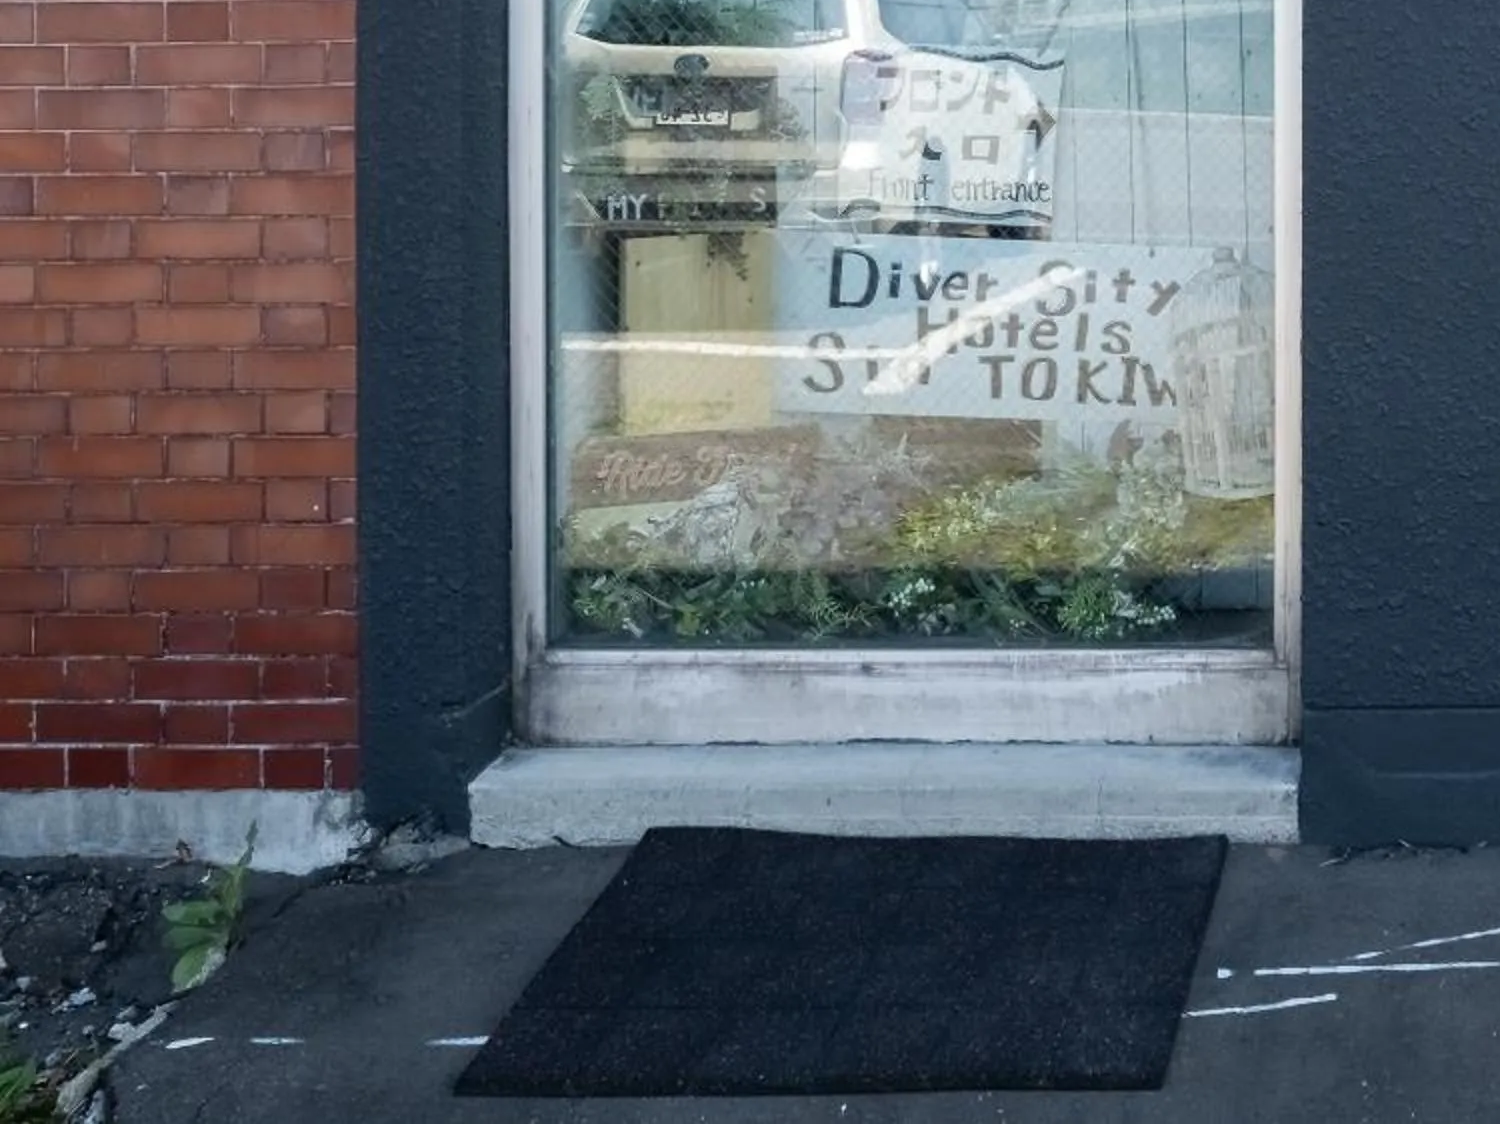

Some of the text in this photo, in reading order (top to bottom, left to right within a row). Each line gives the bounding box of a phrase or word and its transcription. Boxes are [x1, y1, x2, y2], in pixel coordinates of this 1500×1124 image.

[828, 247, 1182, 317] Diver Sity
[915, 307, 1134, 355] Hotels
